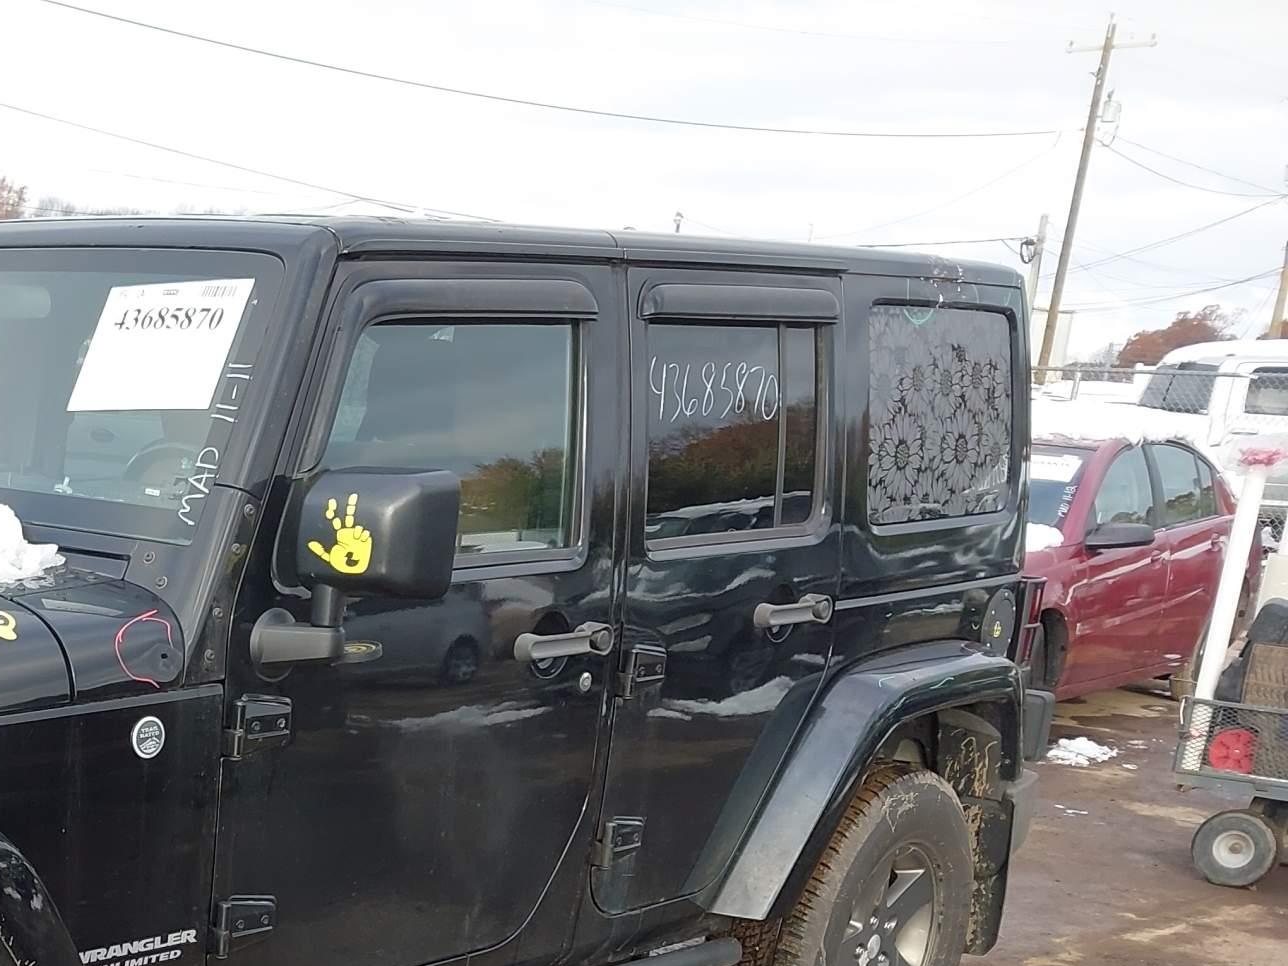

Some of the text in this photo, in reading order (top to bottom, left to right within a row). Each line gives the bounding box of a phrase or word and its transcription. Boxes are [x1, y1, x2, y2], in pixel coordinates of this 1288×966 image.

[114, 306, 225, 331] 43685870
[649, 355, 779, 423] 43685870
[177, 362, 254, 527] MAD 11-11
